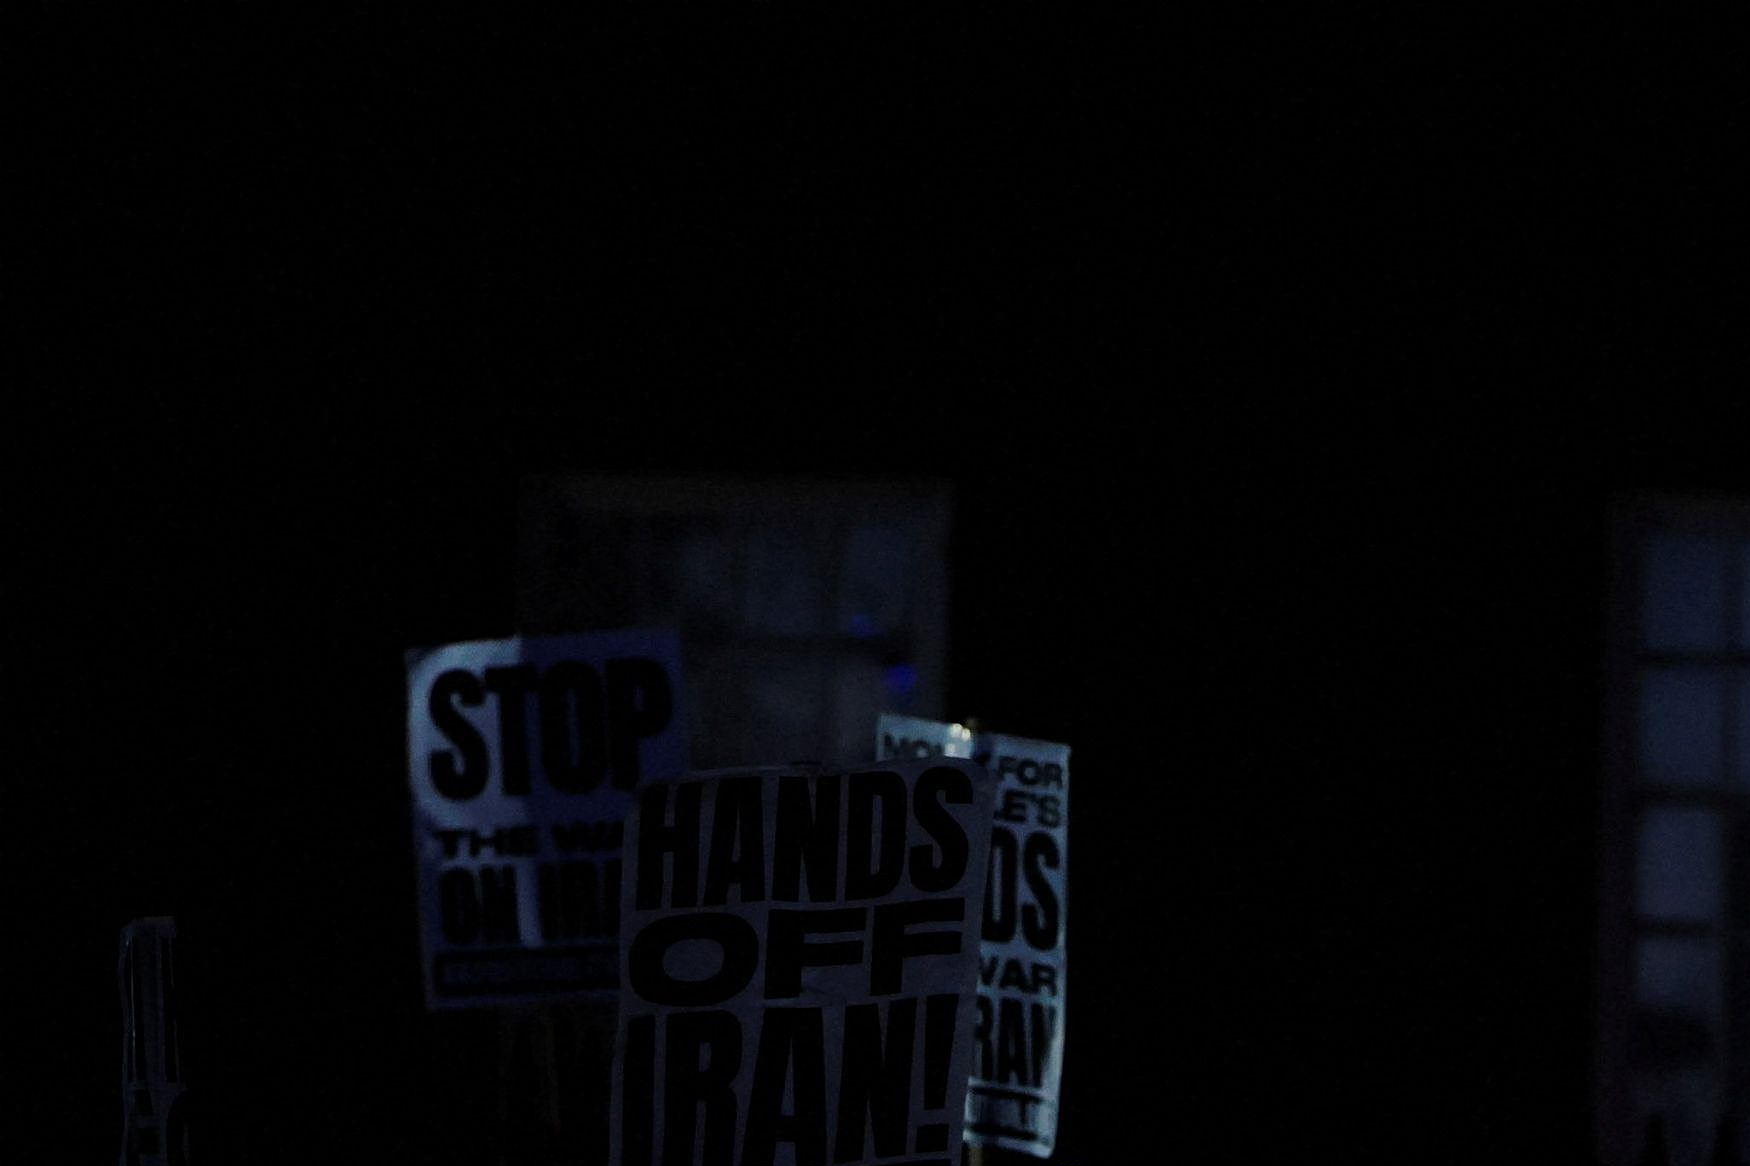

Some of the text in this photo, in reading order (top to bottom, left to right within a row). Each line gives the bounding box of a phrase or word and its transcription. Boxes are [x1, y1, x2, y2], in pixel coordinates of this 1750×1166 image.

[430, 658, 671, 798] STOP
[433, 826, 539, 856] THE
[636, 766, 973, 910] HANDS
[441, 859, 621, 944] ON IR
[627, 898, 965, 1006] OFF
